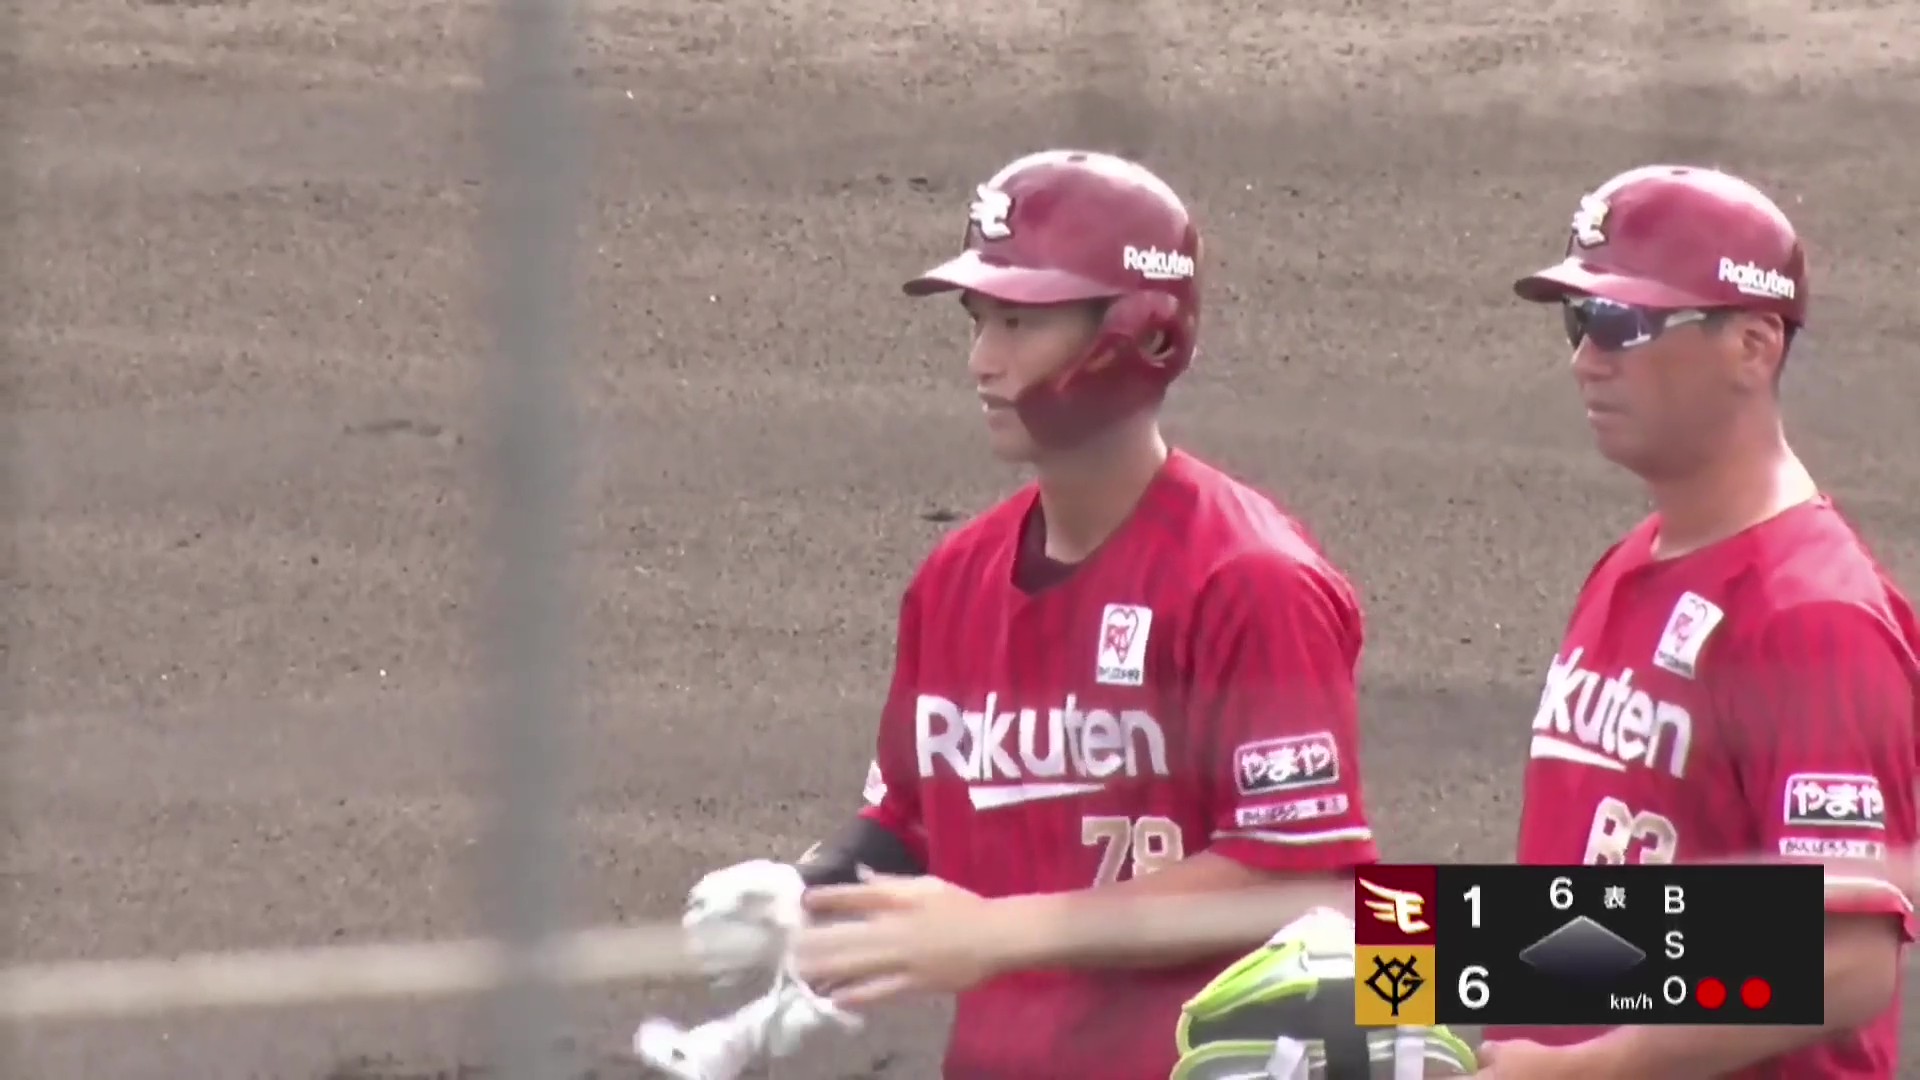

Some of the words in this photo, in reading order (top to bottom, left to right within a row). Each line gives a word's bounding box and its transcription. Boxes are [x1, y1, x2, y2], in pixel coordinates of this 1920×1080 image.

[1123, 245, 1195, 277] Rakuten
[1718, 256, 1796, 300] Rakuten
[1241, 744, 1331, 786] やまや
[1792, 780, 1885, 819] やまや
